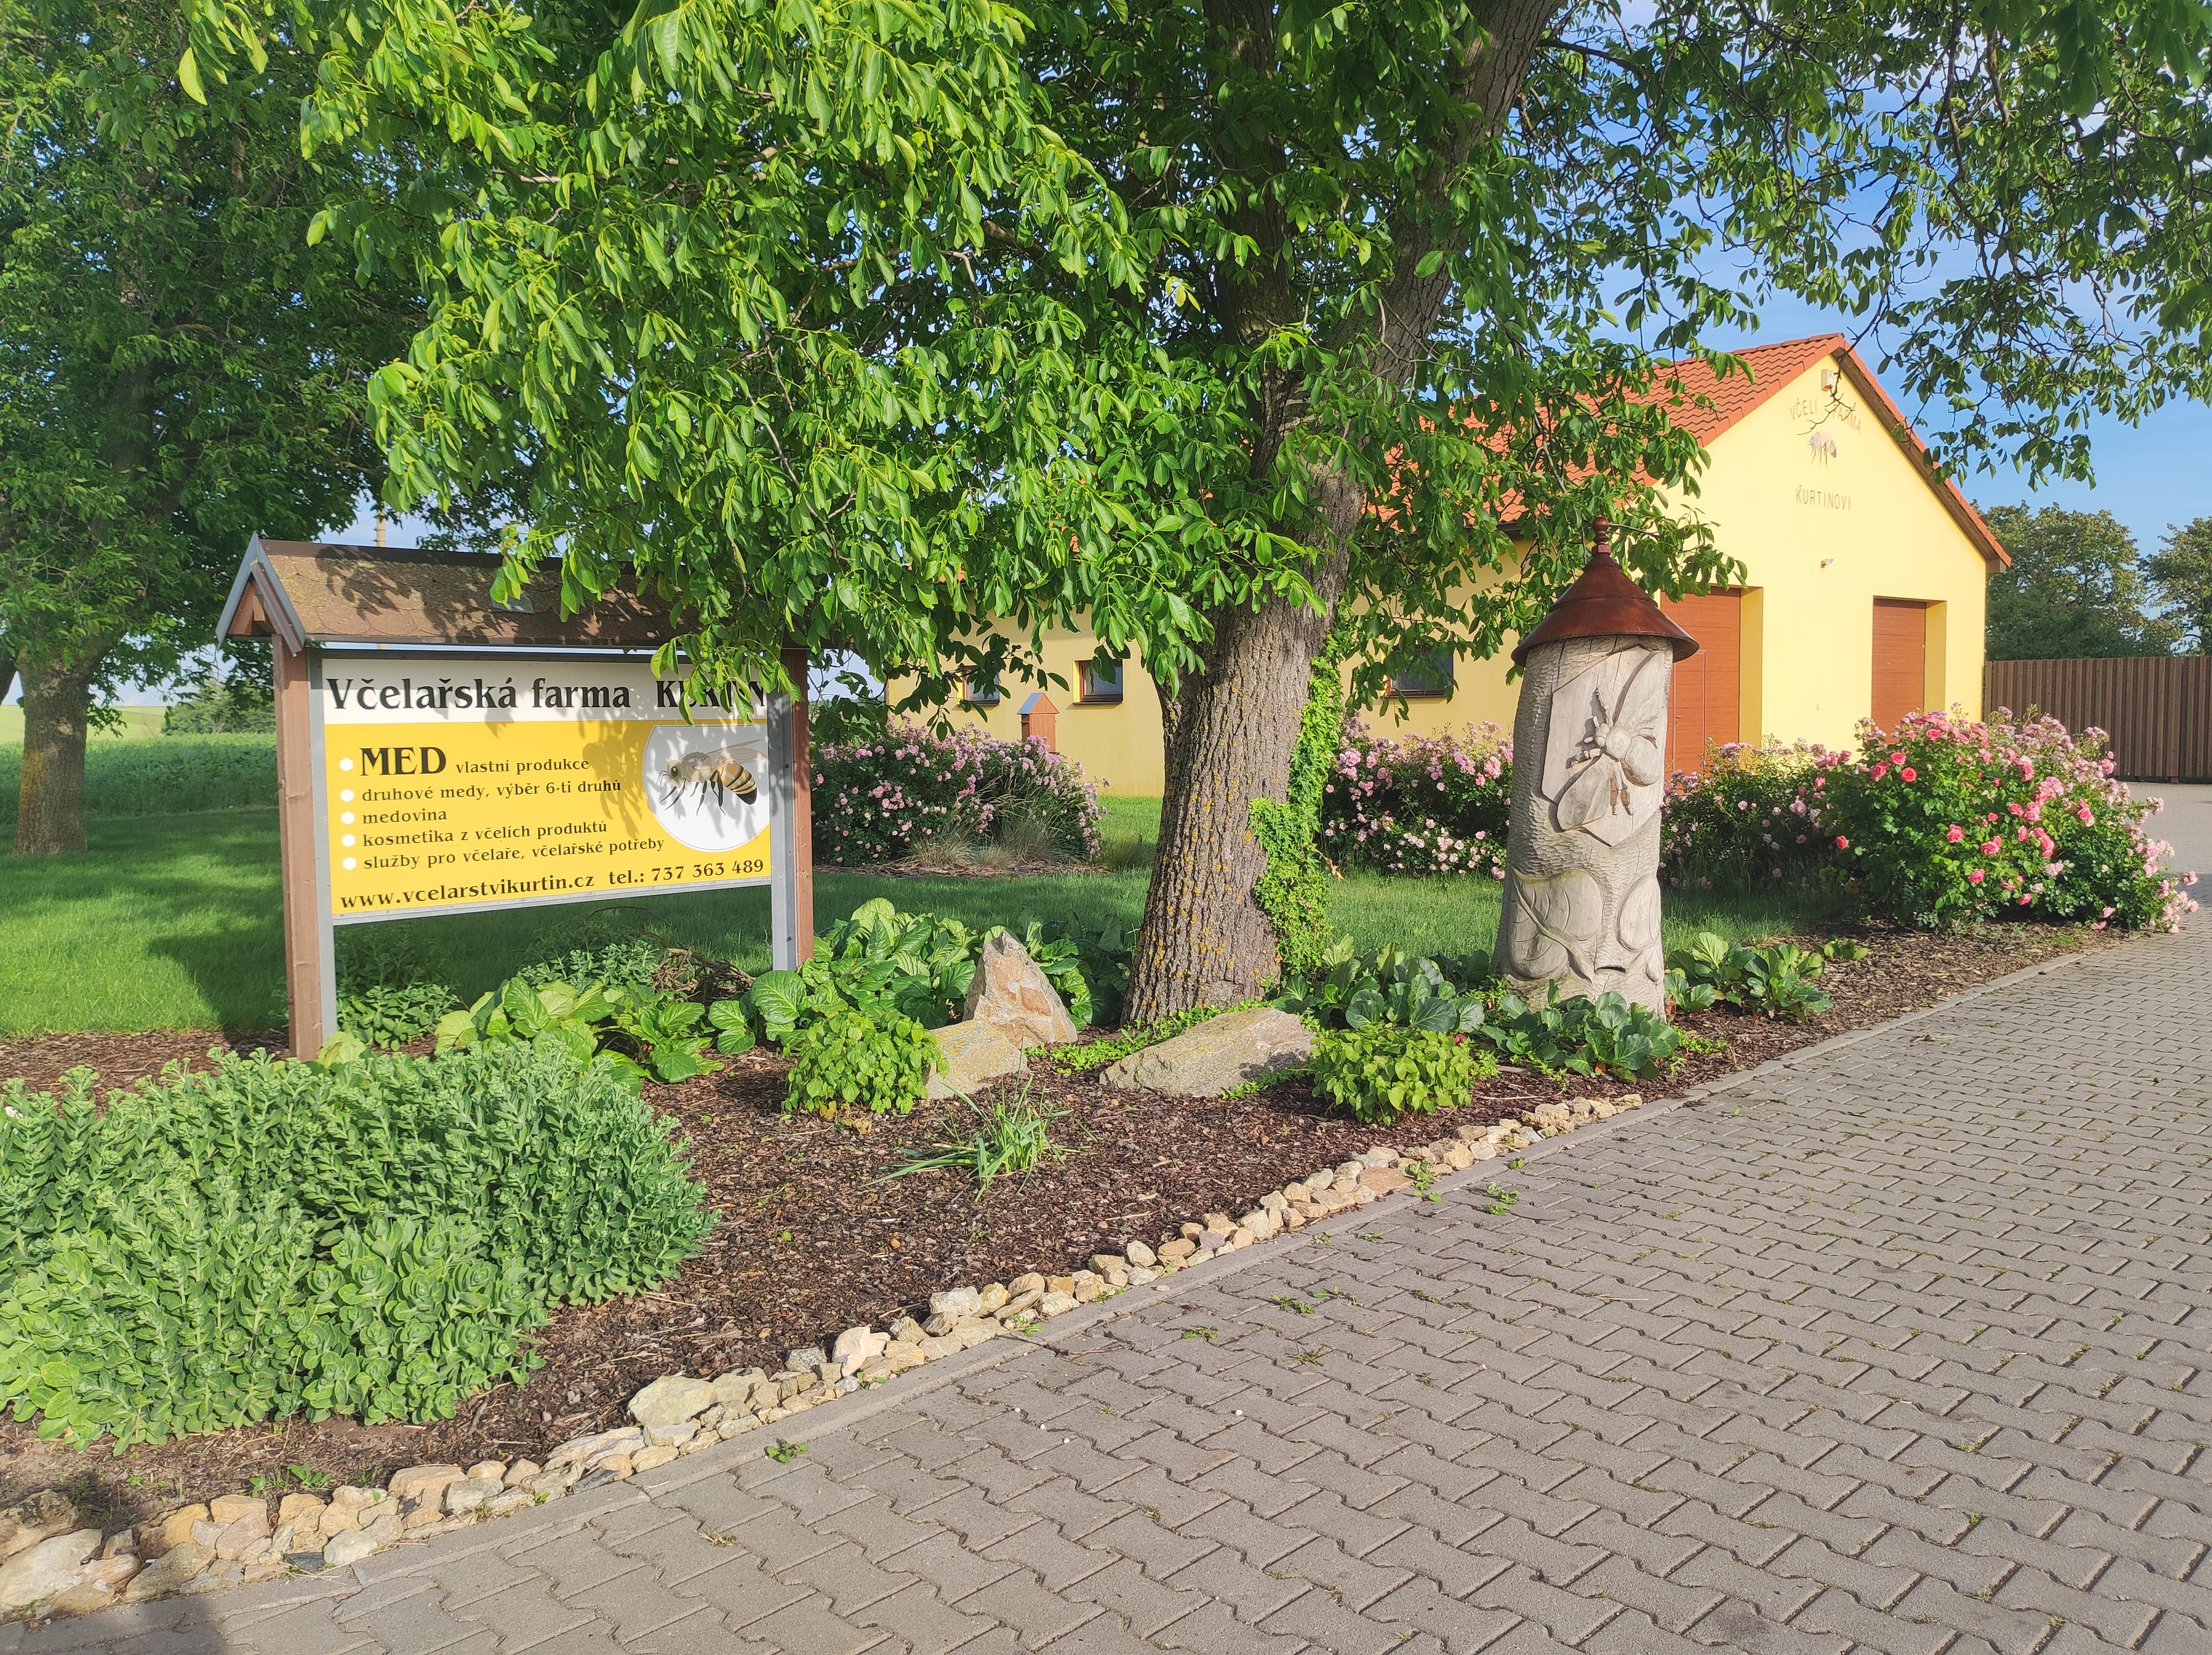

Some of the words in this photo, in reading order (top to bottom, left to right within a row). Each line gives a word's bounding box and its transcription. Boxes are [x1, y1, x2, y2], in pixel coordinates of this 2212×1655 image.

[1796, 488, 1851, 511] KURTINOVI
[325, 677, 518, 710] Včelařská
[531, 678, 631, 708] farma
[360, 746, 446, 776] MED
[456, 760, 509, 773] vlastní
[516, 759, 589, 775] produkce
[362, 786, 434, 801] druhové
[440, 785, 490, 800] medy,
[497, 783, 540, 798] výběr
[546, 781, 571, 794] 6-ti
[577, 779, 622, 792] druhů
[363, 808, 447, 824] medovina
[363, 830, 453, 847] kosmetika
[460, 831, 468, 841] z
[476, 826, 530, 839] včelích
[538, 821, 607, 839] produktů
[363, 855, 421, 869] služby
[427, 853, 456, 869] pro
[463, 848, 525, 862] včelaře,
[531, 840, 603, 858] včelařské
[609, 838, 665, 855] potřeby
[340, 875, 594, 909] www.vcelarstvikurtin.cz
[609, 870, 644, 885] tel.:
[651, 866, 685, 881] 737
[692, 863, 724, 878] 363
[732, 859, 764, 874] 489
